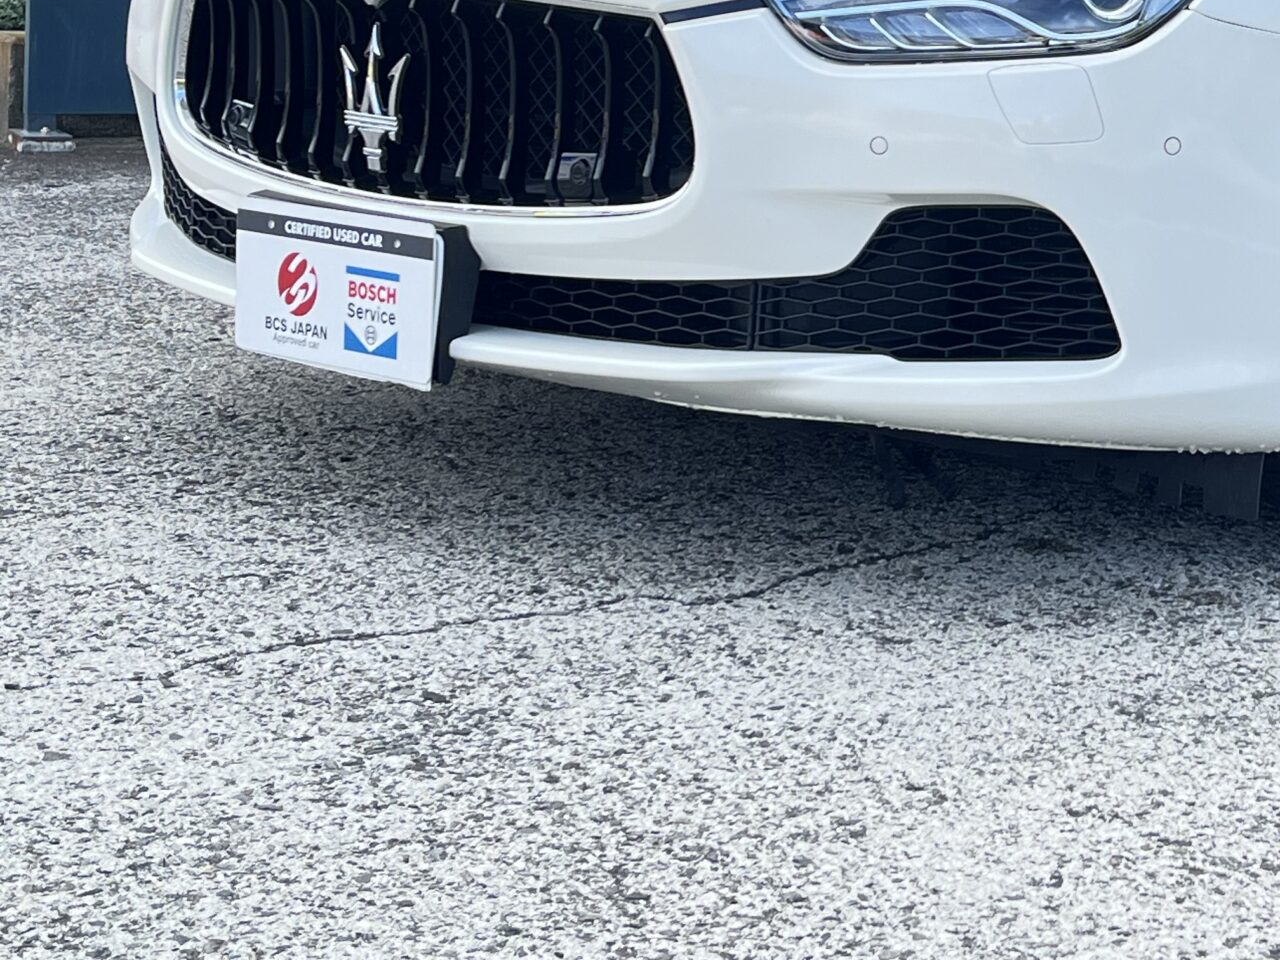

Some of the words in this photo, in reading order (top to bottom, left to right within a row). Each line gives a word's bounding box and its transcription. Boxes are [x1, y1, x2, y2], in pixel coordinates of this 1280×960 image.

[284, 220, 332, 239] CERTIFIED
[333, 227, 360, 244] USED
[361, 232, 383, 248] CAR
[348, 280, 396, 304] BOSCH
[347, 302, 396, 325] Service
[265, 316, 287, 332] BCS
[290, 321, 328, 340] JAPAN
